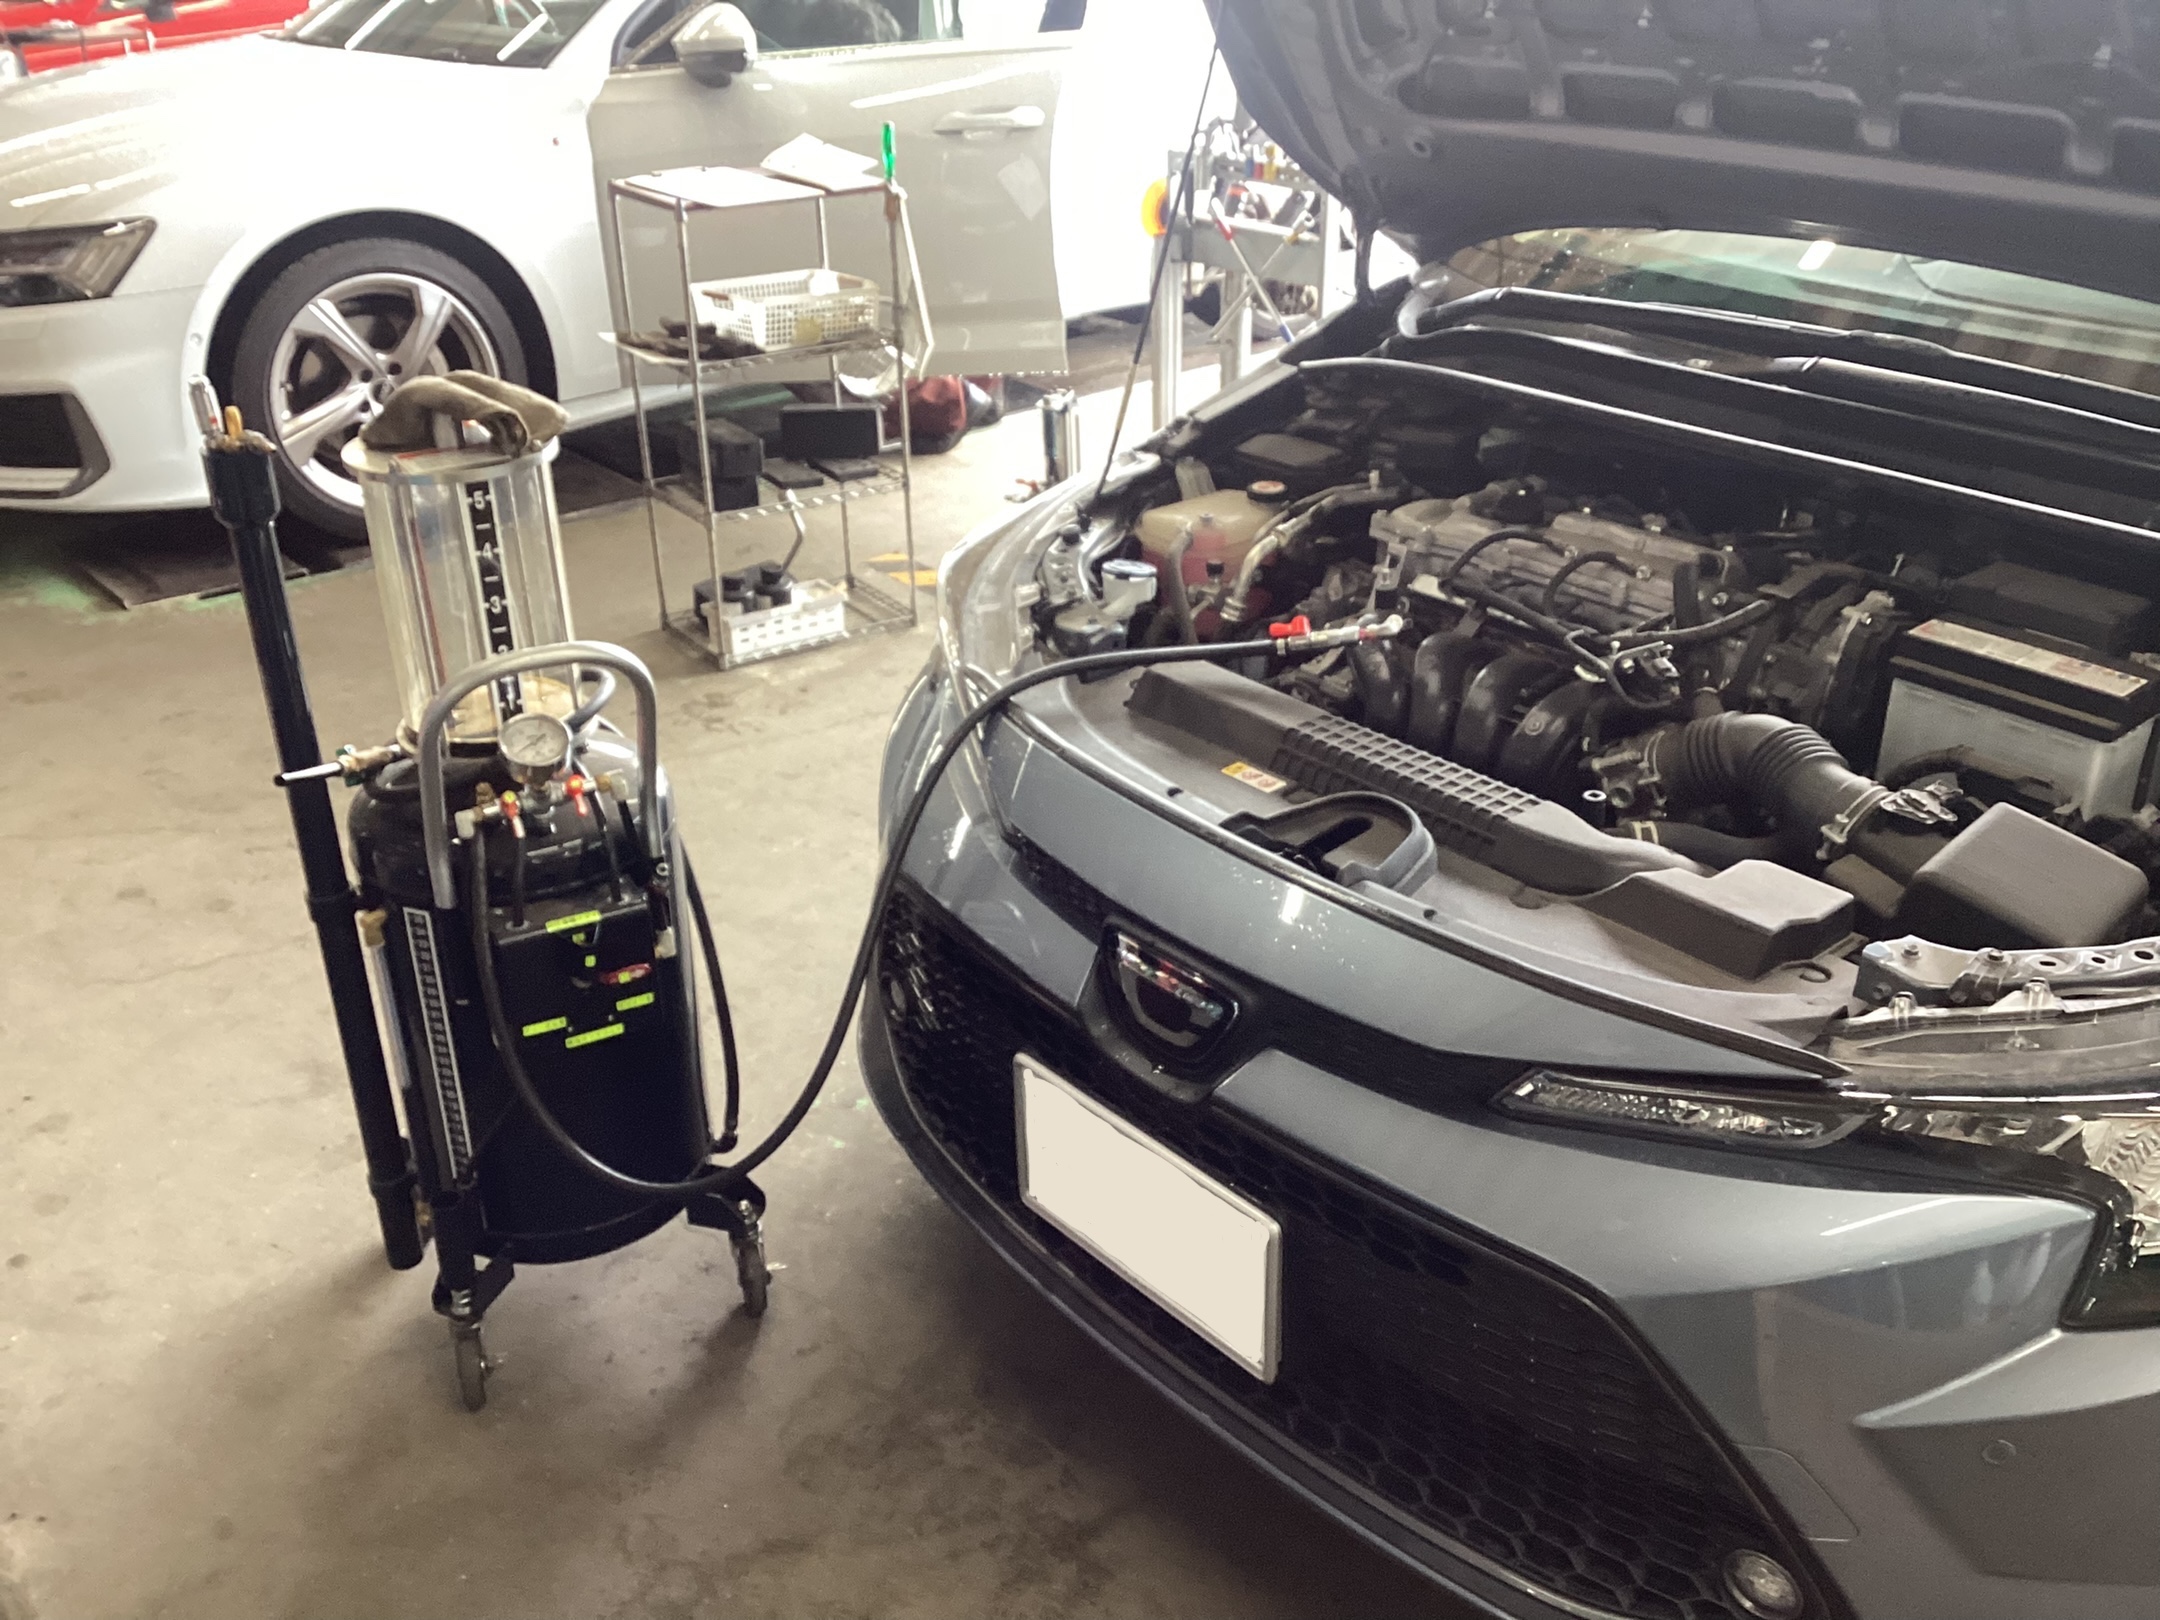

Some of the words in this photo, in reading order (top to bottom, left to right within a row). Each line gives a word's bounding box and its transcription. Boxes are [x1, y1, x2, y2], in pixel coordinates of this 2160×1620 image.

[473, 490, 485, 510] 5
[482, 541, 493, 560] 4
[490, 595, 502, 614] 3
